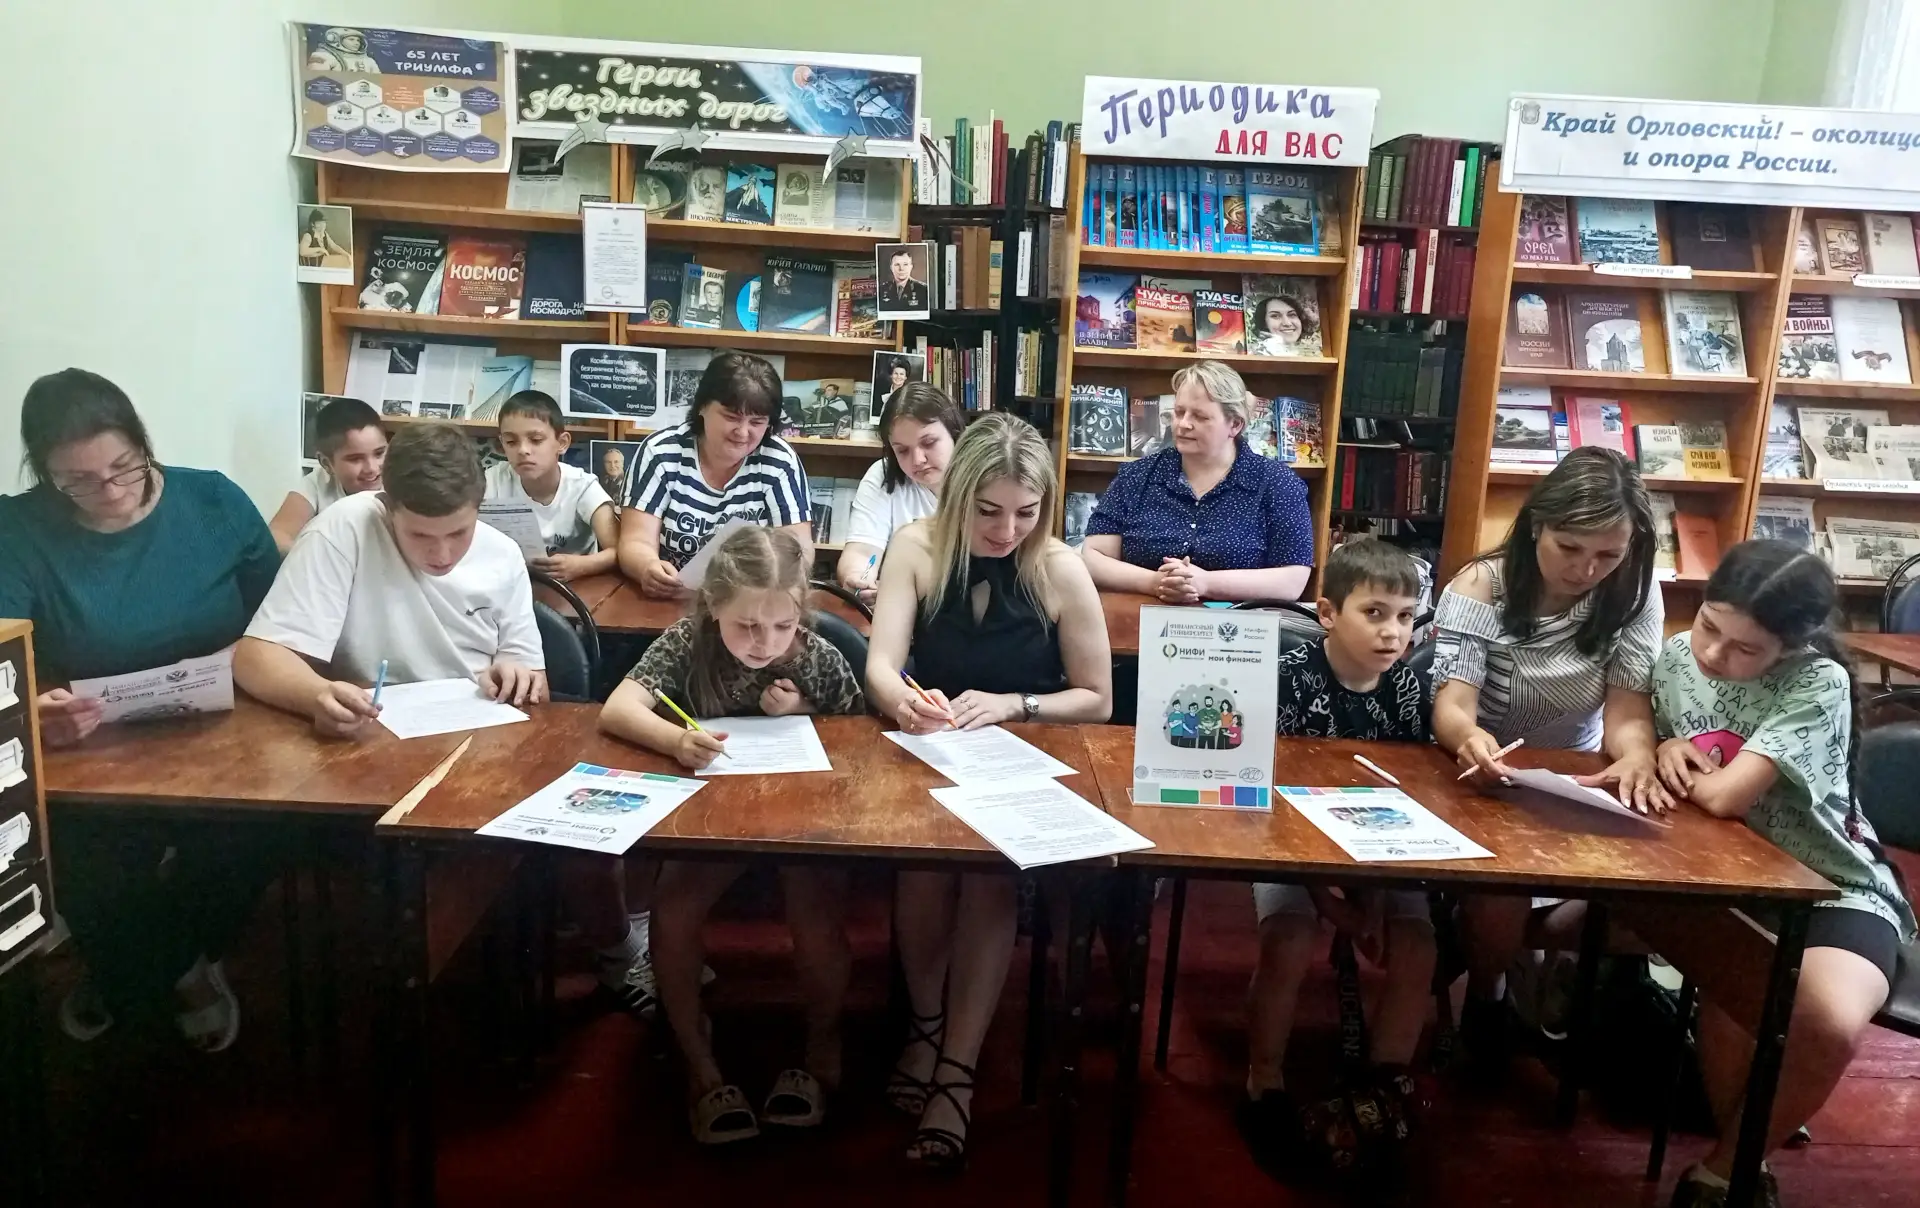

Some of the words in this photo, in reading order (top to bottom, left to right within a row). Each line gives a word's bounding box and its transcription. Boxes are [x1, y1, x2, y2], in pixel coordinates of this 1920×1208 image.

[406, 50, 426, 60] 65
[430, 52, 461, 62] ЛЕТ
[394, 61, 474, 76] ТРИУМФА
[596, 57, 702, 95] Герои
[521, 83, 691, 121] звездных
[698, 94, 789, 129] дорог
[1100, 84, 1335, 144] Периодика
[1541, 110, 1616, 138] Край
[1626, 114, 1785, 142] Орловский!
[1215, 129, 1268, 156] ДЛЯ
[1284, 131, 1343, 160] ВАС
[1623, 151, 1639, 166] и
[1647, 150, 1730, 174] опора
[1737, 151, 1838, 174] России.
[1251, 171, 1309, 188] ГЕРОИ
[387, 244, 432, 257] ЗЕМЛЯ
[1524, 241, 1555, 255] ОРЕЛ
[377, 258, 436, 272] КОСМОС
[766, 258, 792, 269] ЮРИЙ
[794, 263, 827, 272] ГАГАРИН
[450, 263, 520, 282] КОСМОС
[1137, 288, 1190, 304] ЧУДЕСА
[531, 300, 564, 309] ДОРОГА
[1137, 299, 1190, 311] ПРИКЛЮЧЕНИЯ
[1793, 318, 1830, 331] ВОЙНЫ
[1078, 338, 1108, 347] СЛАВЫ
[1070, 384, 1123, 398] ЧУДЕСА
[1070, 395, 1123, 408] ПРИКЛЮЧЕНИЯ
[1179, 648, 1205, 656] НИФИ
[1226, 655, 1262, 664] финансы
